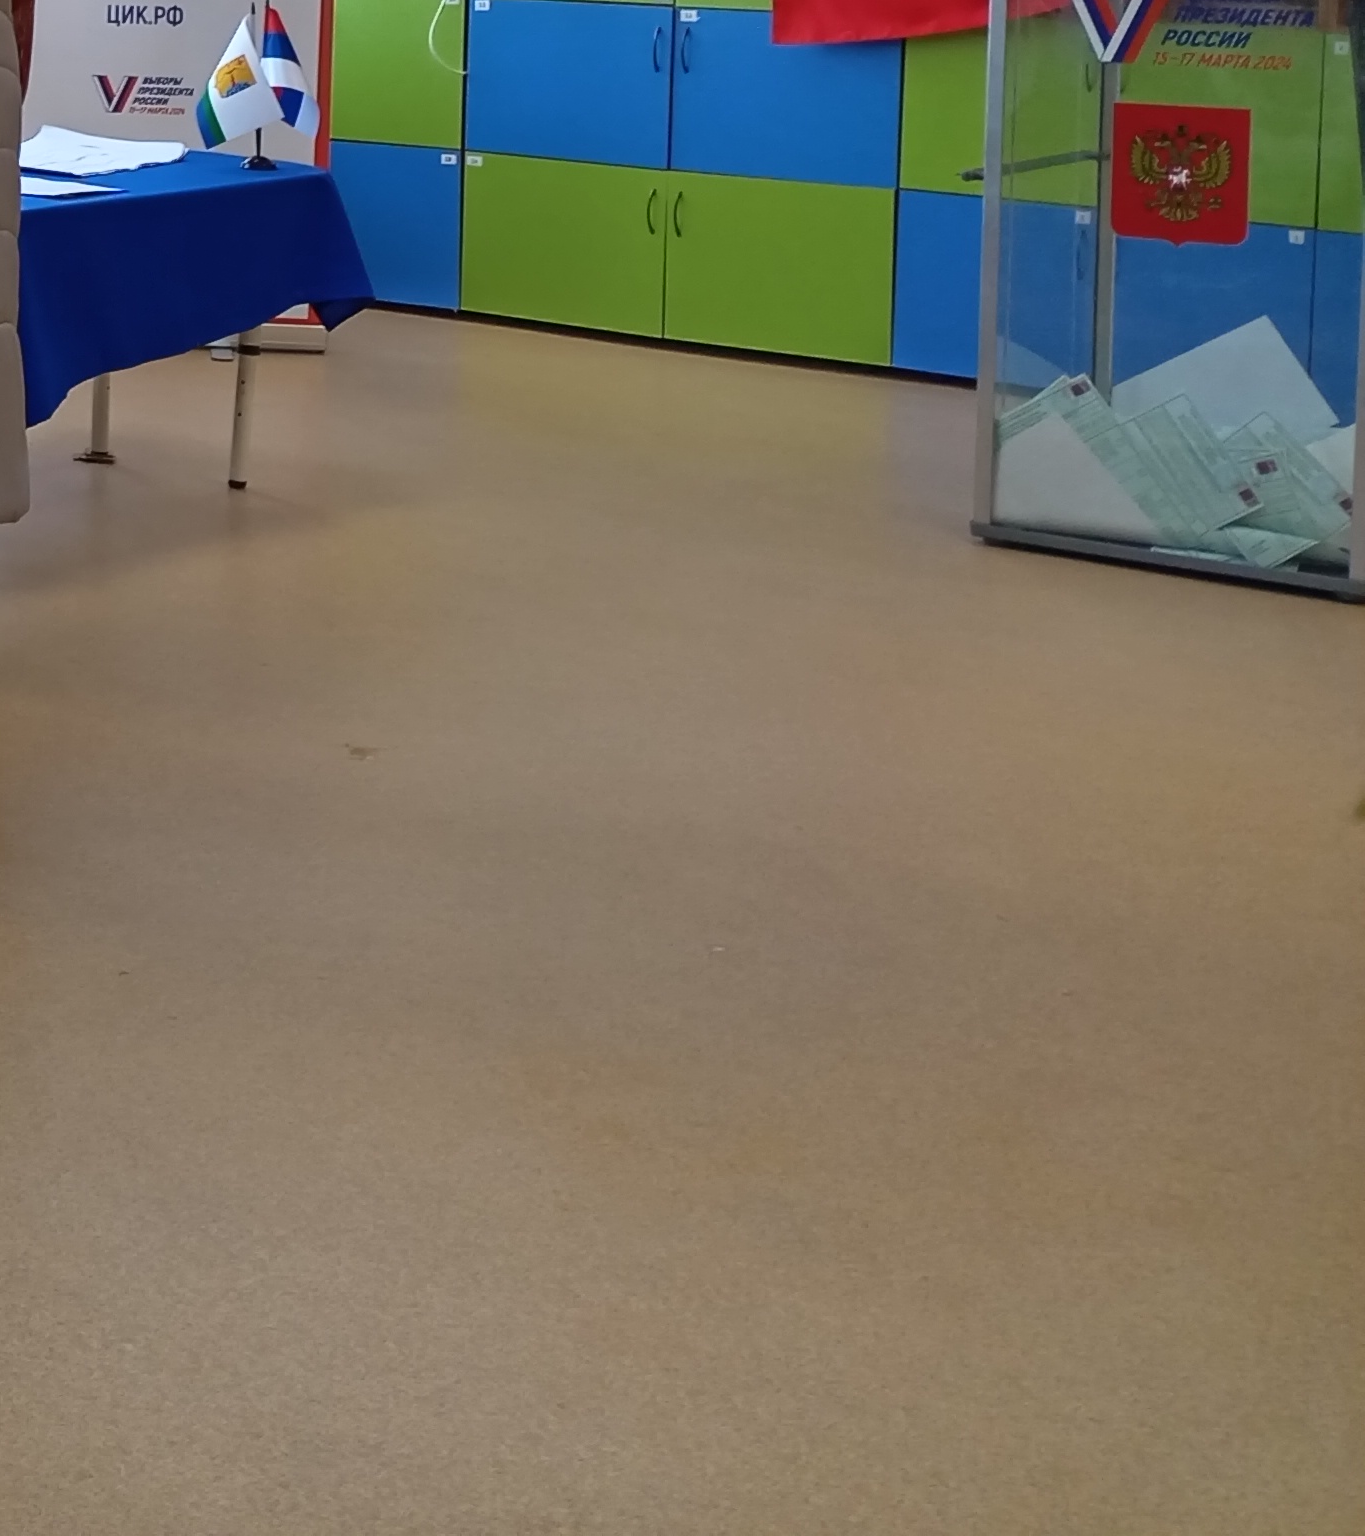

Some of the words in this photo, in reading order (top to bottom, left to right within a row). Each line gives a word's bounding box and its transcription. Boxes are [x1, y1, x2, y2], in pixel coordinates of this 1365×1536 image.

[106, 4, 184, 27] ЦИК.РФ
[1173, 5, 1316, 27] ПРЕЗИДЕНТА
[1160, 28, 1253, 49] РОССИИ
[1196, 52, 1251, 68] МАРТА
[1252, 55, 1293, 71] 2024
